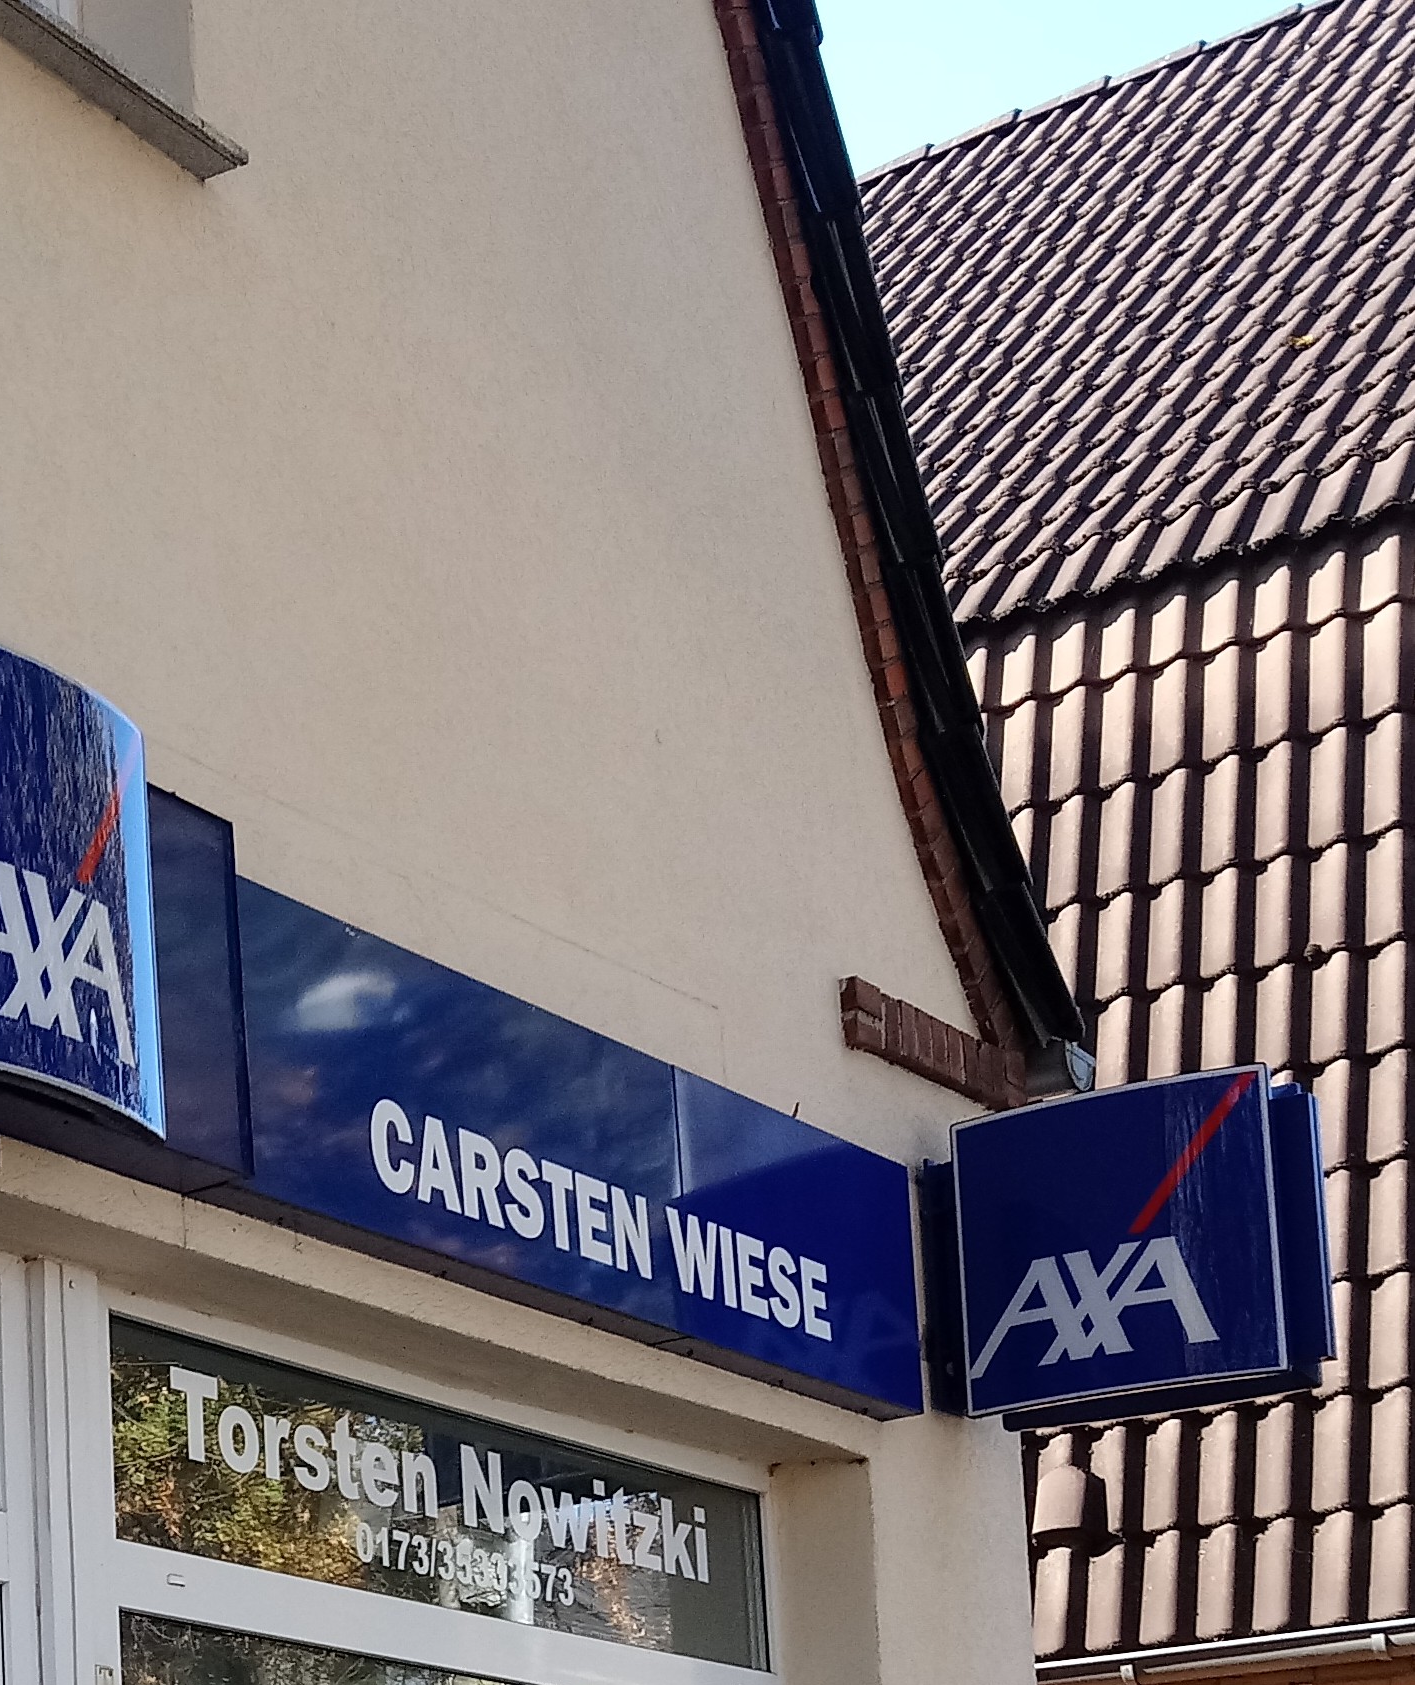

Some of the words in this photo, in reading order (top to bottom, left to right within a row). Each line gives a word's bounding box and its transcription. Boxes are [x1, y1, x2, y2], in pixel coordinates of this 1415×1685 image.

[371, 1099, 652, 1279] CARSTEN
[665, 1205, 833, 1342] WIESE
[971, 1236, 1221, 1379] AXA
[170, 1366, 438, 1518] Torsten
[460, 1442, 709, 1583] Nowitzki
